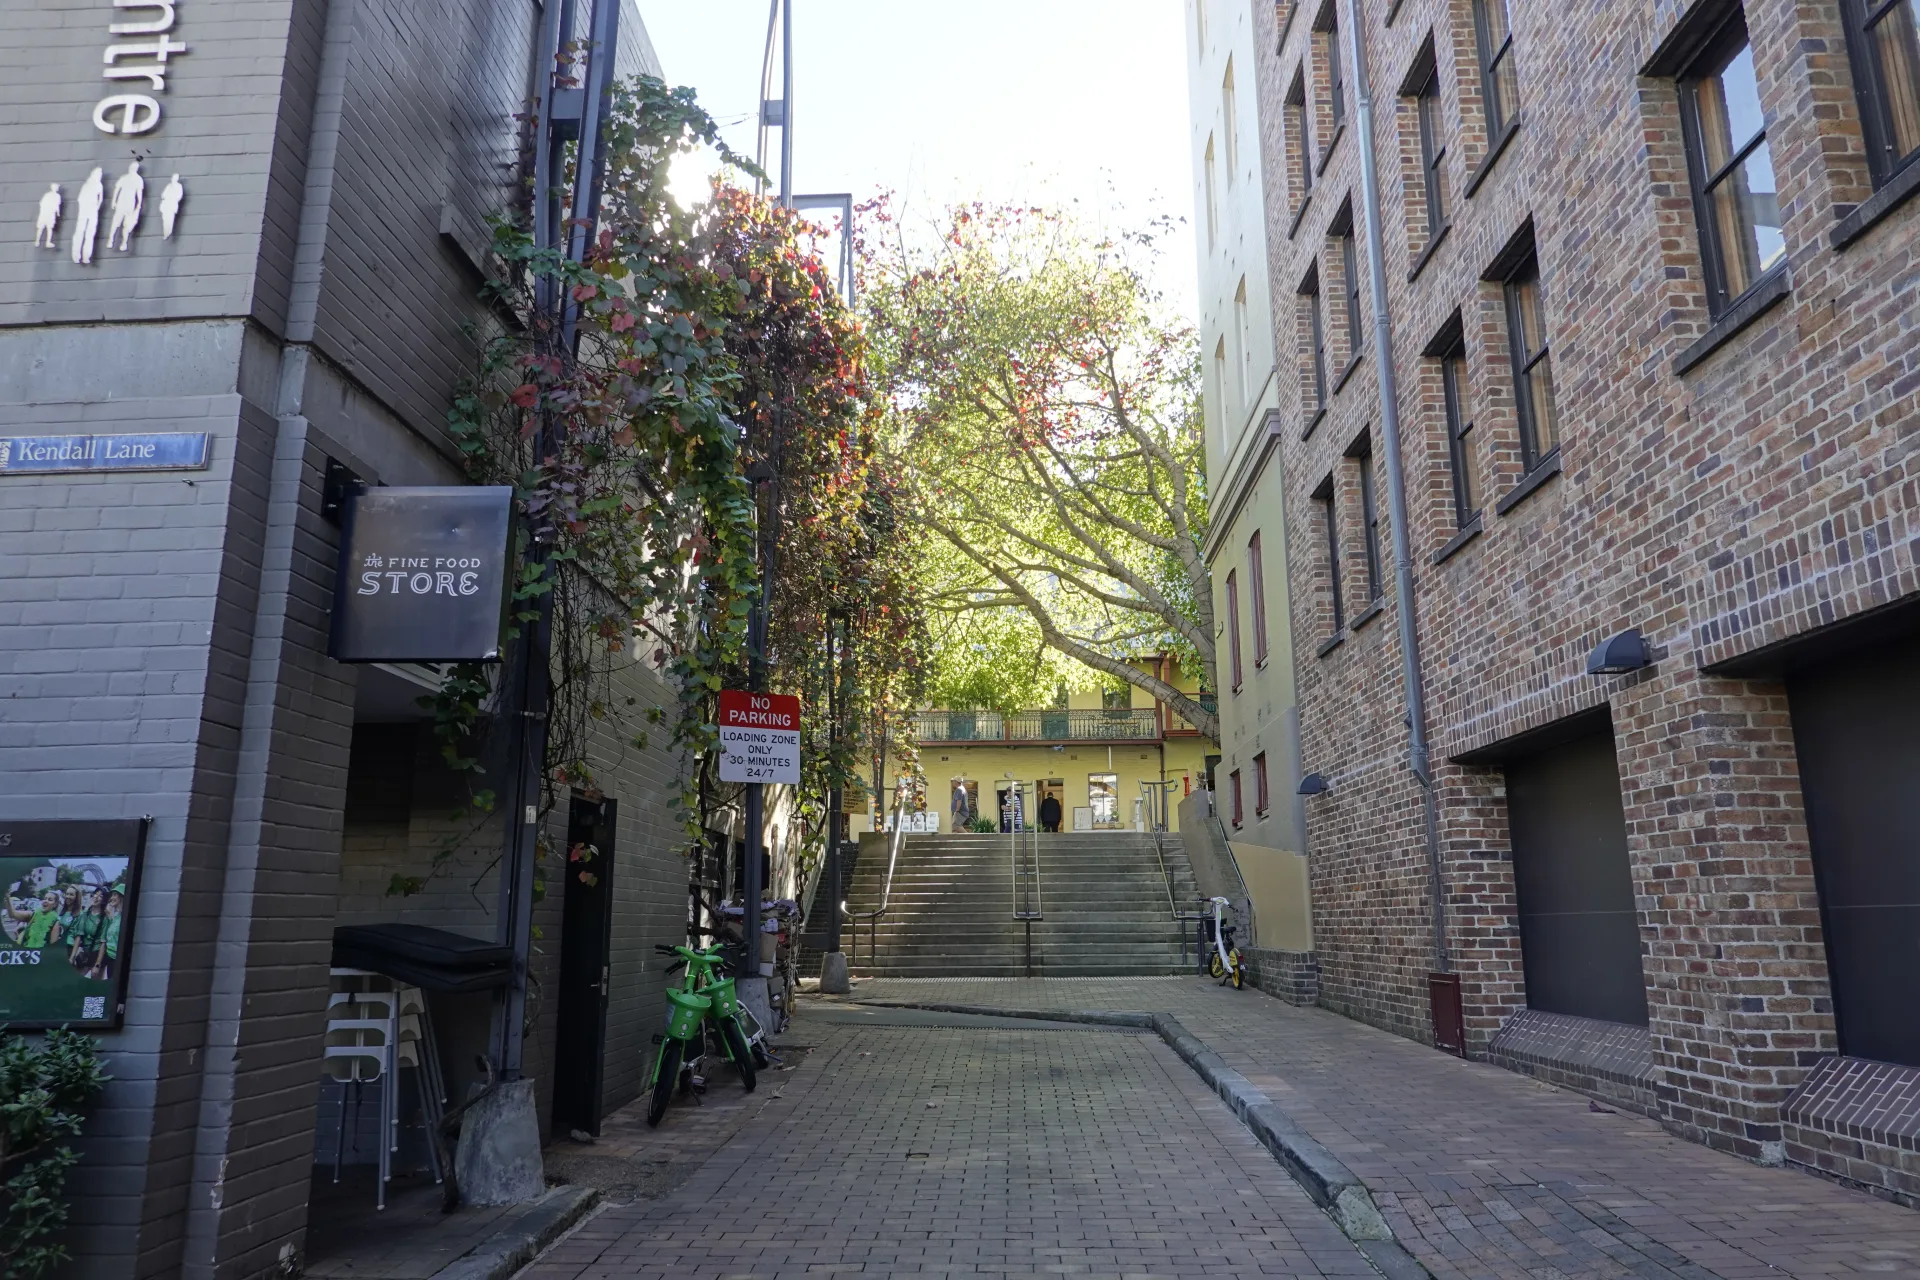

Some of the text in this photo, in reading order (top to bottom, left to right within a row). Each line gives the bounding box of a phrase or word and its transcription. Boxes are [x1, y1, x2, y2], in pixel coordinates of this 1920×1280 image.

[18, 440, 156, 461] Kendall Lane
[364, 553, 481, 568] the FINE FOOD
[357, 571, 479, 597] STORE
[751, 697, 771, 710] NO
[729, 710, 791, 727] PARKING
[723, 732, 797, 744] LOADING ZONE
[748, 745, 773, 754] ONLY
[729, 755, 790, 767] 30 MINUTES
[746, 768, 774, 778] 24/7
